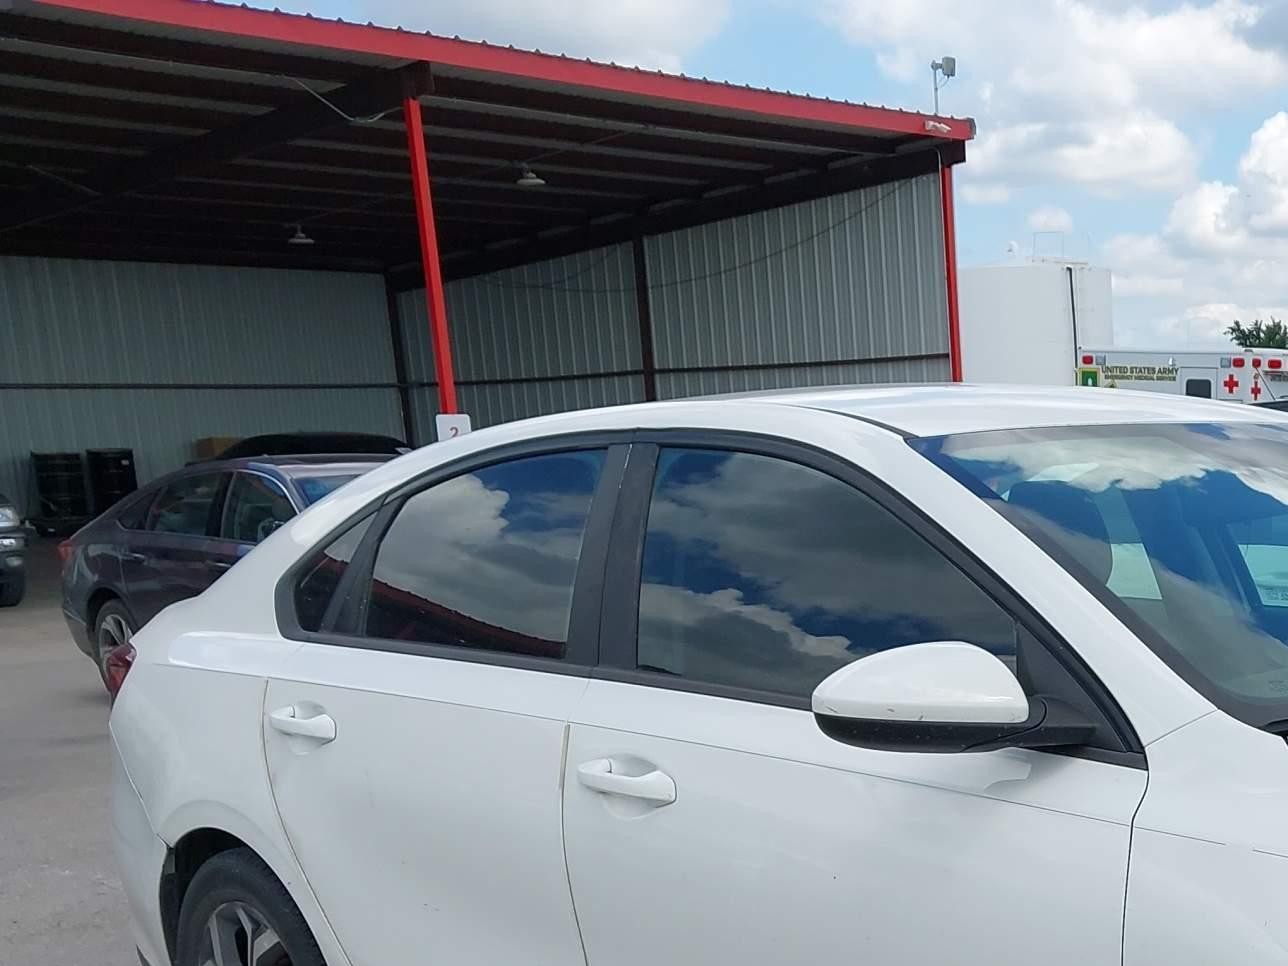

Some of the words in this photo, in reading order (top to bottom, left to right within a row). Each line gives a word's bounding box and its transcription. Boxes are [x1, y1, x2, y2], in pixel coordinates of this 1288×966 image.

[1101, 366, 1129, 374] UNITED
[1129, 366, 1156, 374] STATES
[1156, 367, 1179, 375] ARMY
